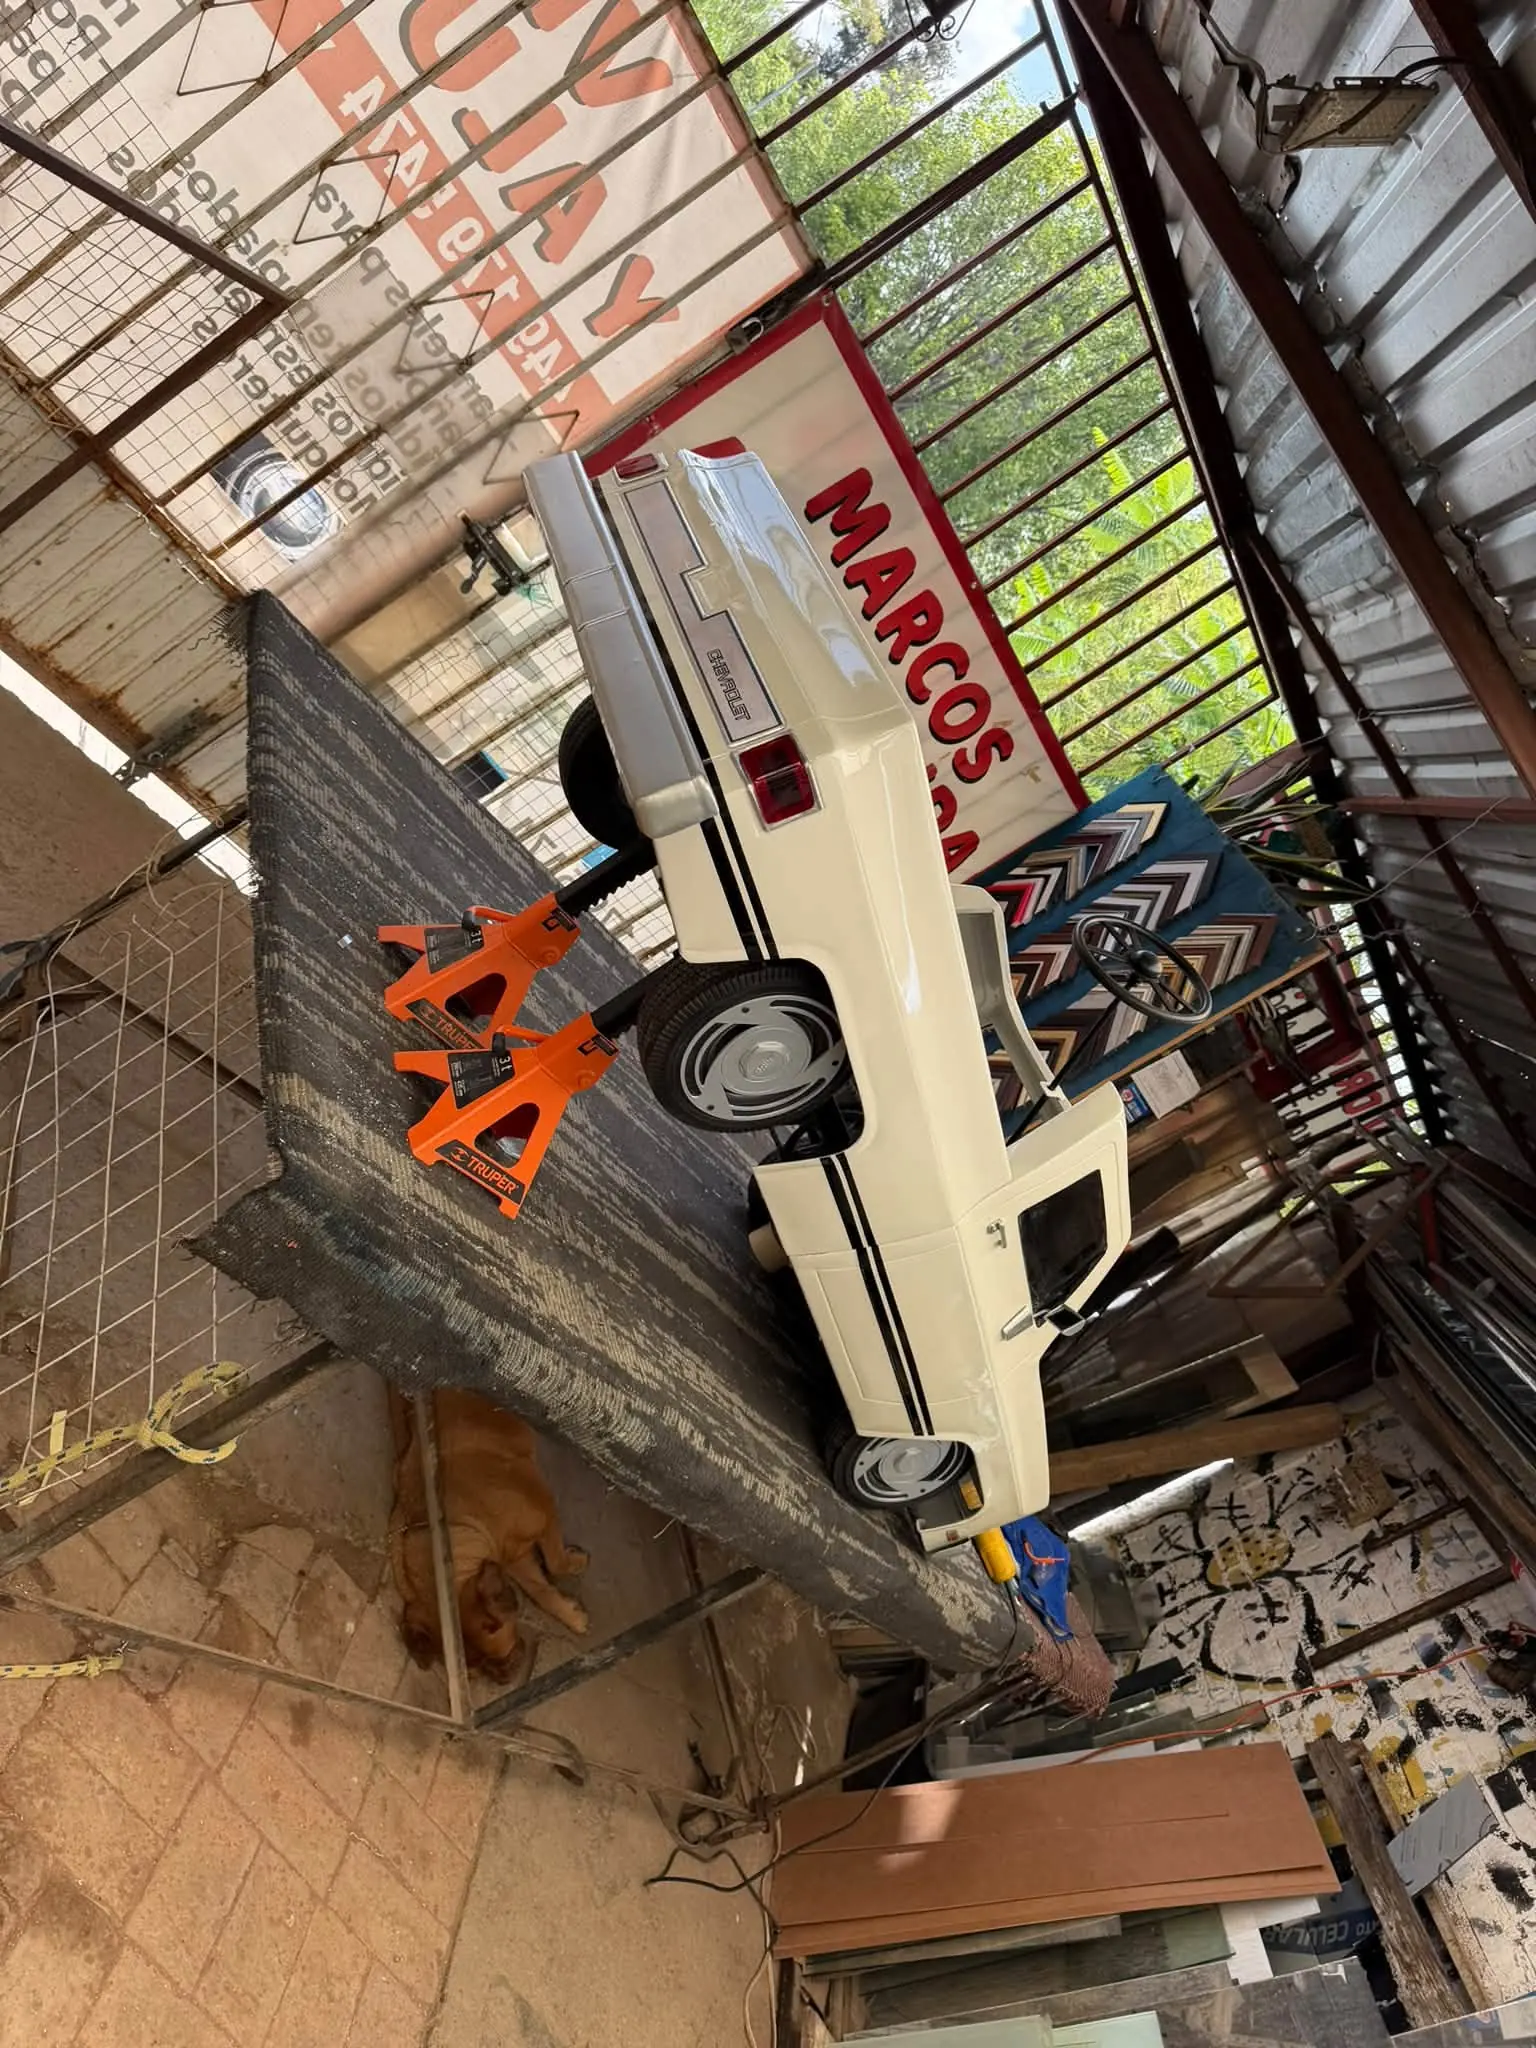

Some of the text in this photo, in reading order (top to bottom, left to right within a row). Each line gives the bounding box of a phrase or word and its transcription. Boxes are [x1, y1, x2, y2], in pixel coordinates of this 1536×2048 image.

[804, 467, 1014, 783] MARCOS
[705, 647, 750, 722] CHEVROLET
[434, 1016, 476, 1049] TRUPE
[466, 1155, 517, 1195] TRUPER
